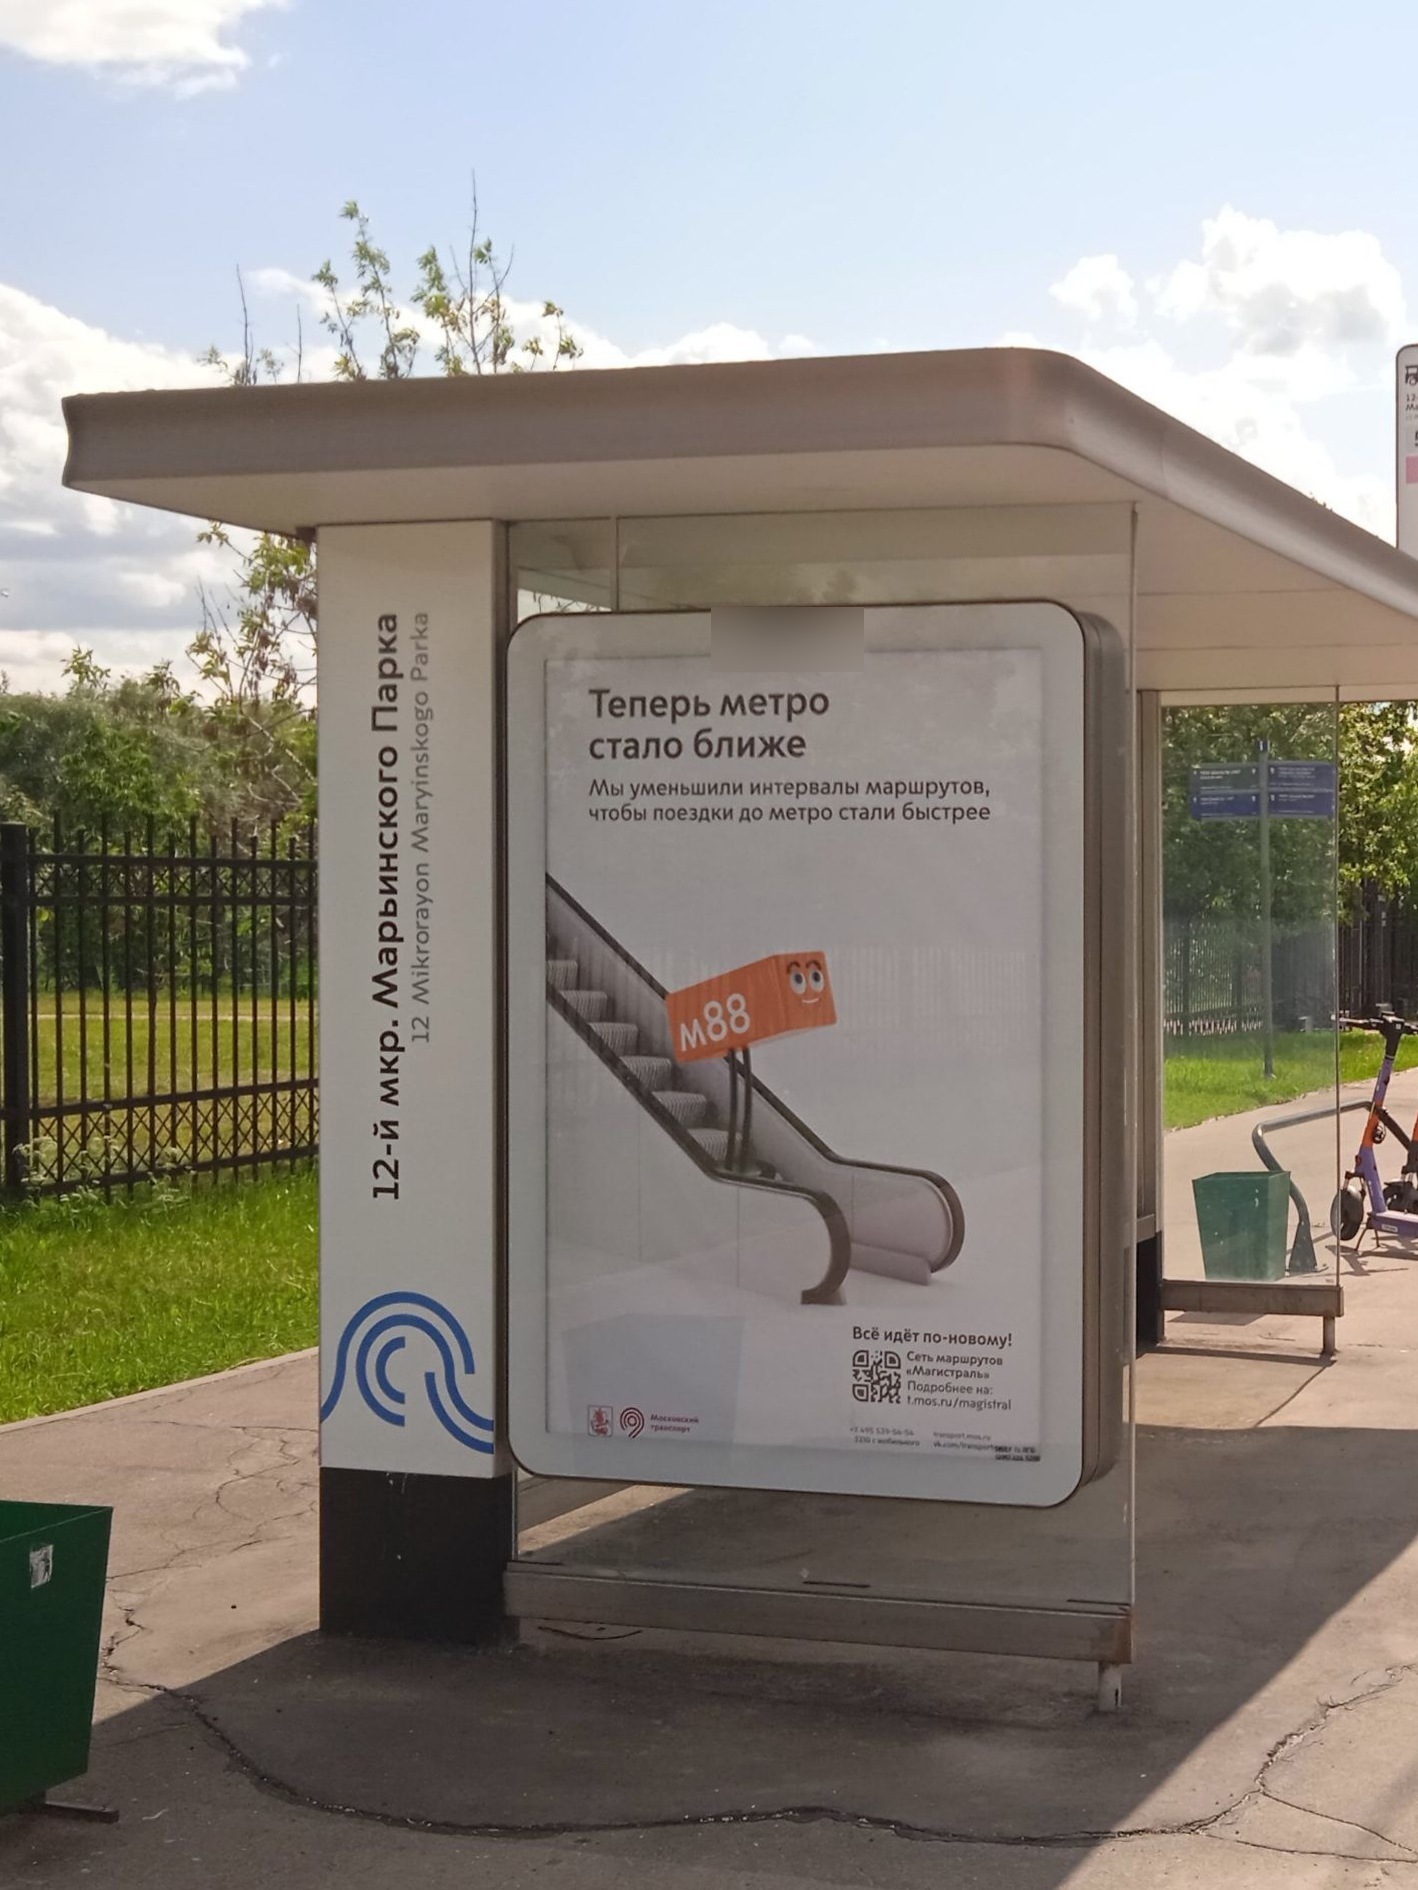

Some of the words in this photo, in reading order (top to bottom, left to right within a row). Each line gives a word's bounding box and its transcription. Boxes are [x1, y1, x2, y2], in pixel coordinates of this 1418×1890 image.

[410, 612, 429, 682] Parka
[371, 613, 405, 732] Парка
[588, 688, 711, 724] Теперь
[719, 692, 830, 722] метро
[588, 736, 683, 760] стало
[693, 727, 807, 759] ближе
[410, 691, 434, 853] Maryinskogo
[588, 778, 624, 797] Мы
[629, 781, 744, 801] уменьшили
[749, 781, 859, 800] интервалы
[865, 780, 990, 799] маршрутов,
[588, 803, 647, 822] чтобы
[653, 807, 734, 824] поездки
[738, 807, 764, 824] до
[768, 806, 833, 825] метро
[838, 806, 895, 821] стали
[901, 801, 991, 825] быстрее
[371, 745, 405, 1008] Марьинского
[410, 862, 434, 1005] Mikrorayon
[411, 1016, 430, 1044] 12
[379, 1019, 406, 1107] мкр.
[372, 1119, 400, 1200] 12-й
[852, 1326, 880, 1341] Всё
[884, 1328, 920, 1344] идёт
[923, 1332, 1012, 1349] по-новому!
[906, 1350, 933, 1363] Сеть
[936, 1354, 1003, 1366] маршрутов
[906, 1365, 990, 1380] «Магистраль»
[907, 1380, 973, 1394] Подробнее
[975, 1385, 993, 1395] на:
[907, 1395, 1012, 1412] t.mos.ru/magistral
